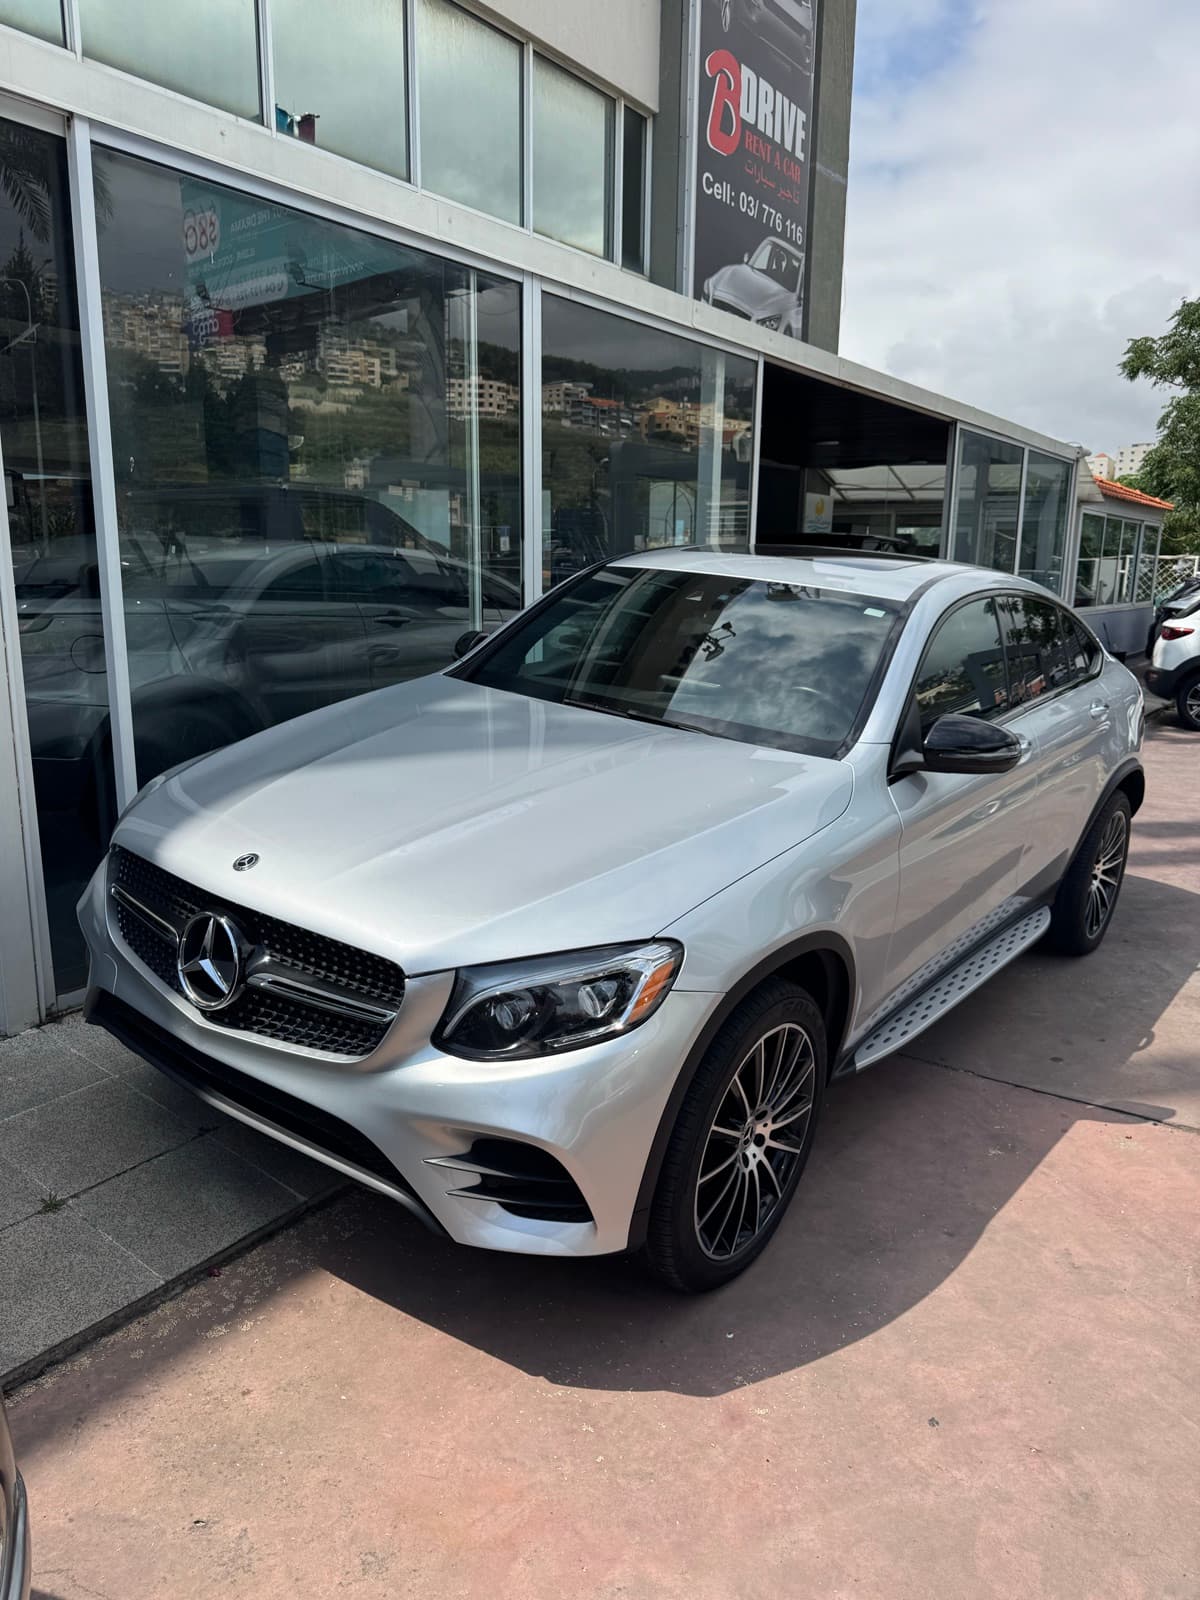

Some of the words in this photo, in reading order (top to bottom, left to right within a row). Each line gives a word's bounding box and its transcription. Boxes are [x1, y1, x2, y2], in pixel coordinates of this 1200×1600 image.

[740, 63, 807, 162] DRIVE
[745, 129, 771, 163] RENT
[774, 150, 782, 171] A
[783, 156, 801, 185] CAR
[702, 171, 735, 207] Cell:
[739, 191, 760, 219] 03/
[762, 203, 783, 233] 776
[785, 218, 803, 246] 116
